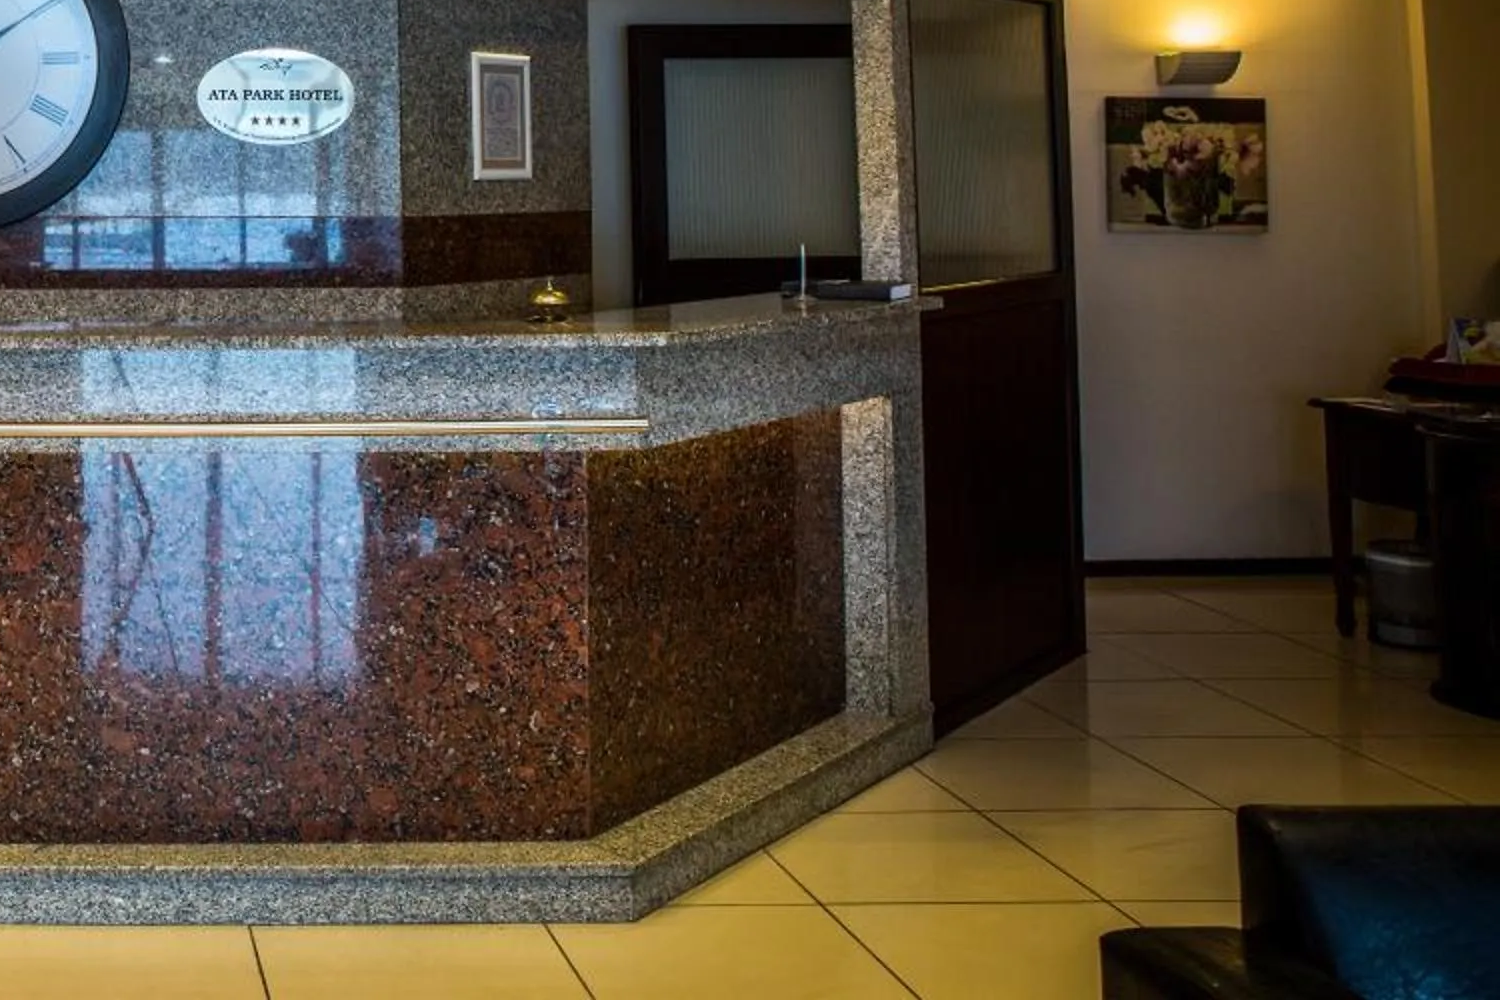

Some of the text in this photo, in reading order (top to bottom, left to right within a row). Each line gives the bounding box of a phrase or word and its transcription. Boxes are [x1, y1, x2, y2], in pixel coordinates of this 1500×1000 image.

[208, 88, 344, 101] ATA PARK HOTEL
